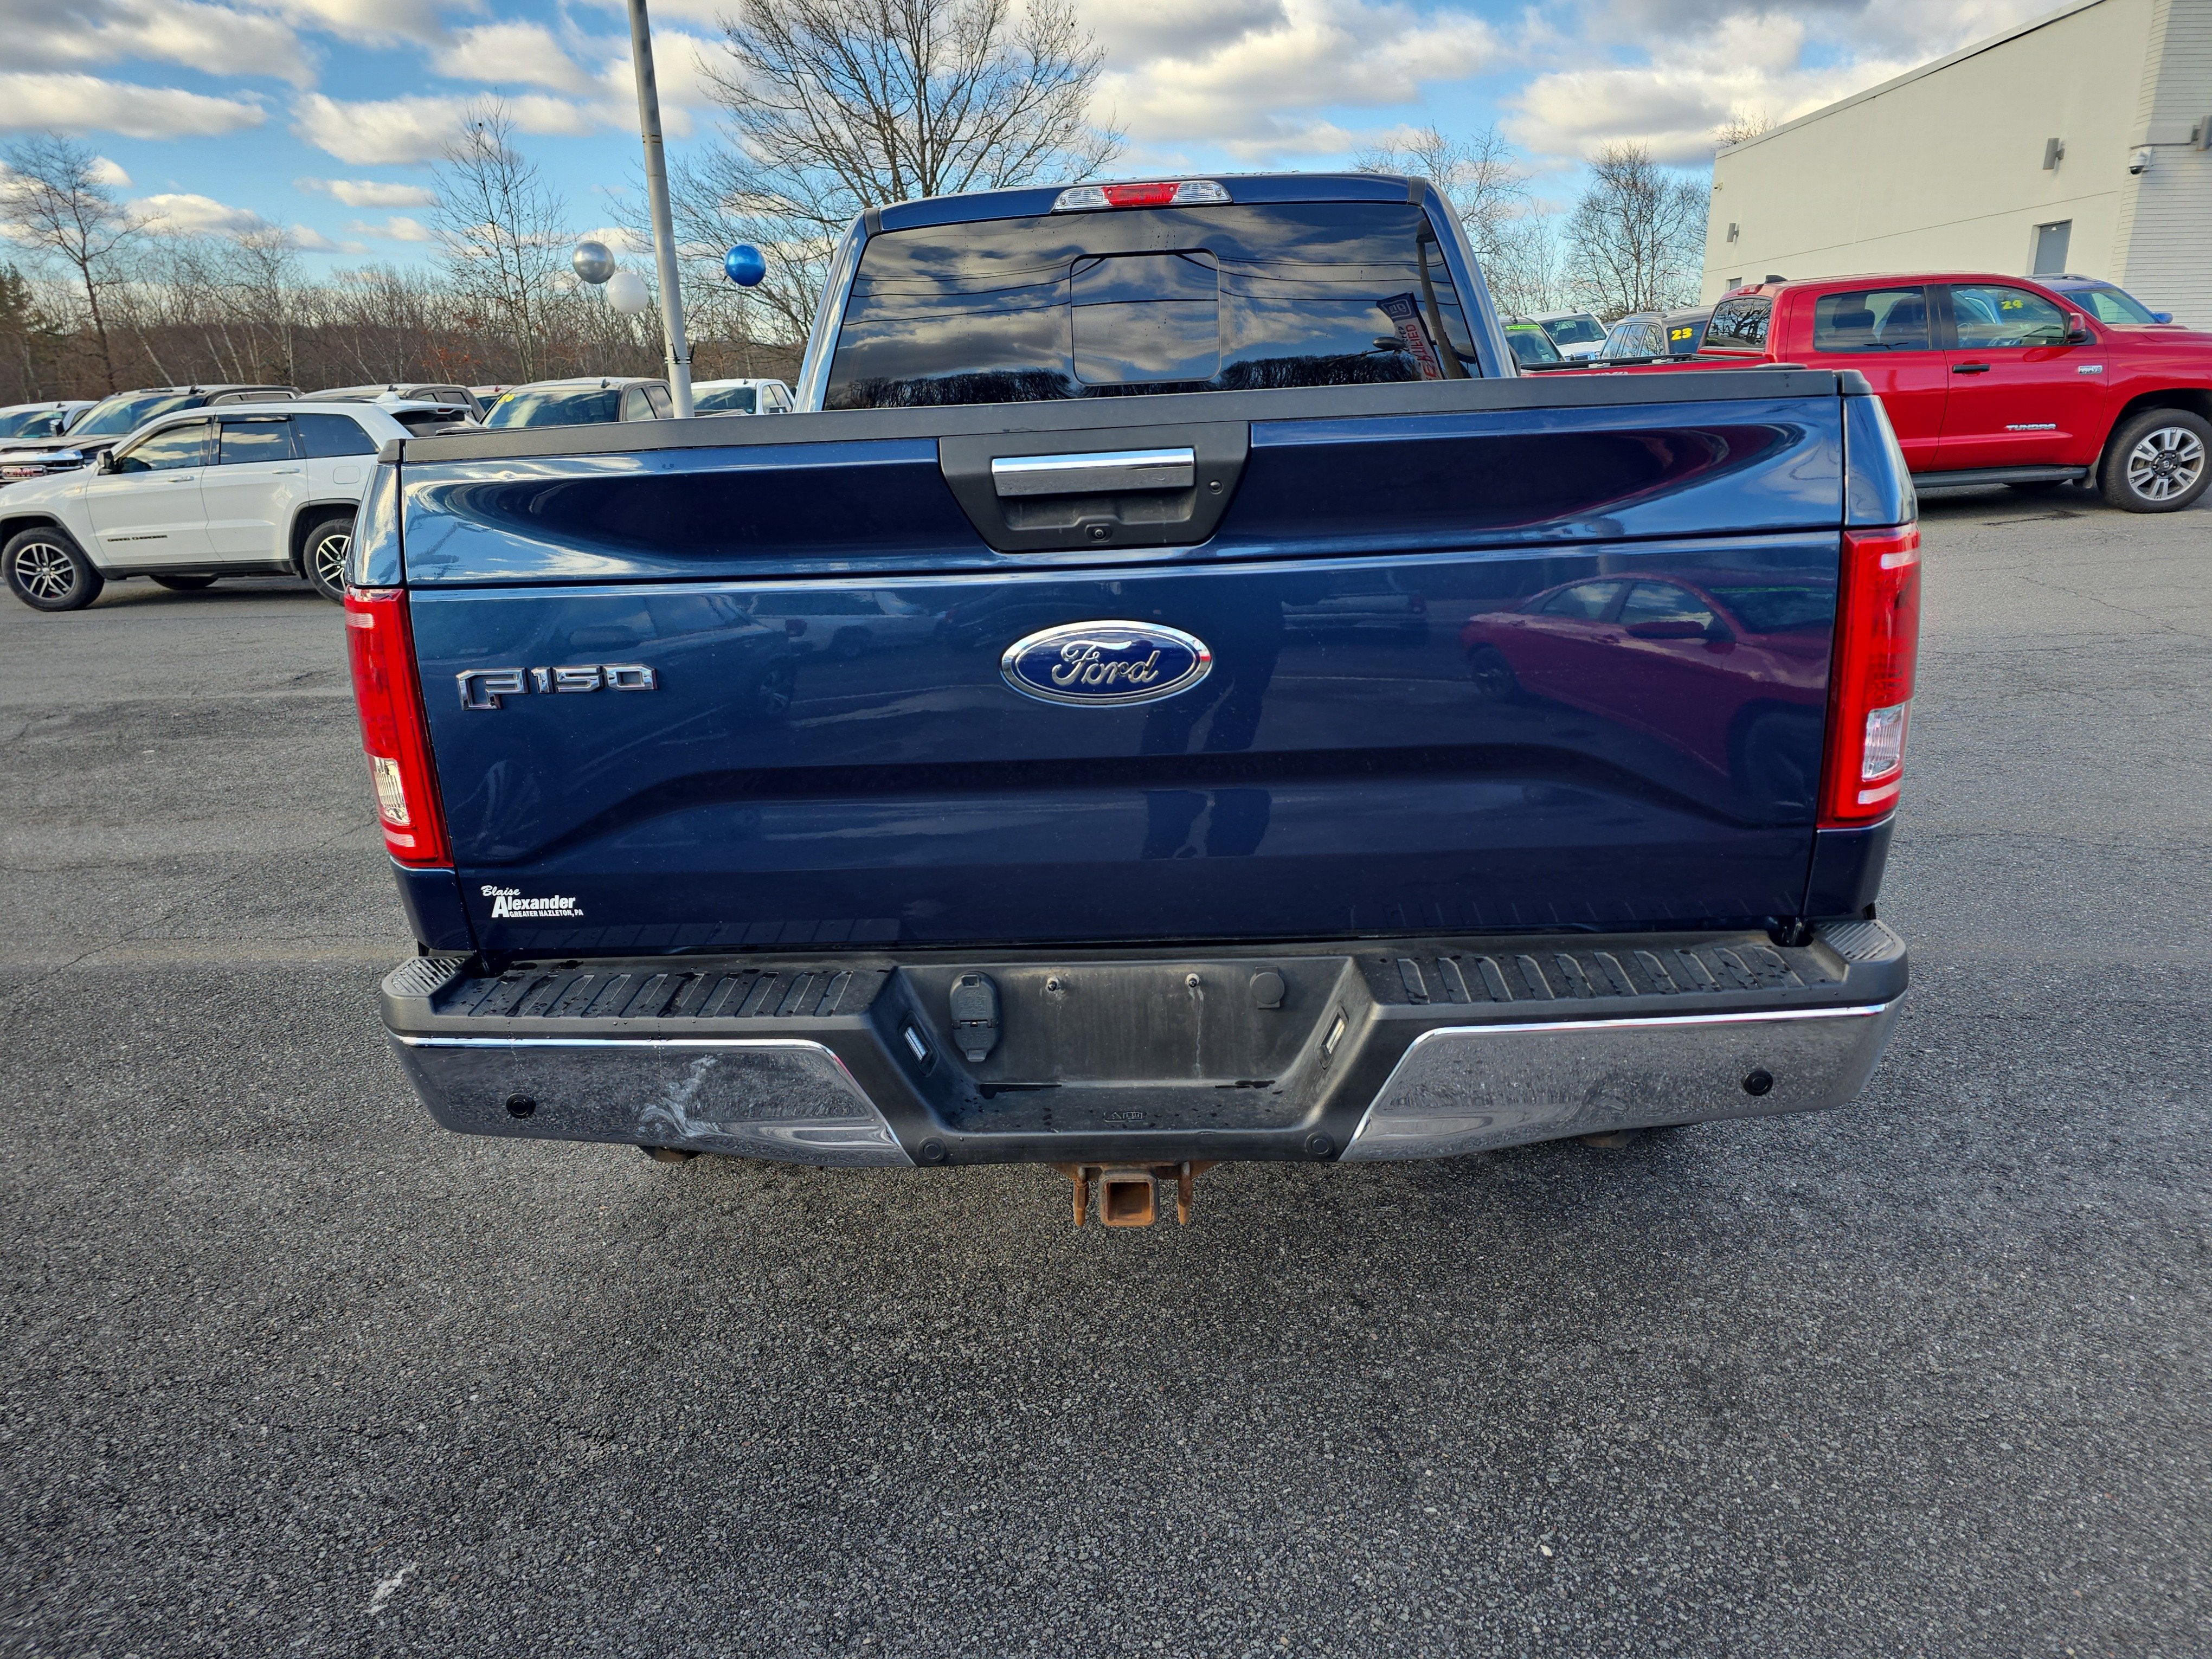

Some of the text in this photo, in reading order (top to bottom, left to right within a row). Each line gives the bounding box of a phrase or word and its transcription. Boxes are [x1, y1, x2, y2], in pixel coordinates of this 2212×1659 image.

[1671, 327, 1693, 340] 23
[3, 467, 43, 477] GMC
[1052, 640, 1161, 686] Ford
[480, 885, 521, 896] Blaise
[491, 895, 576, 918] Alexander
